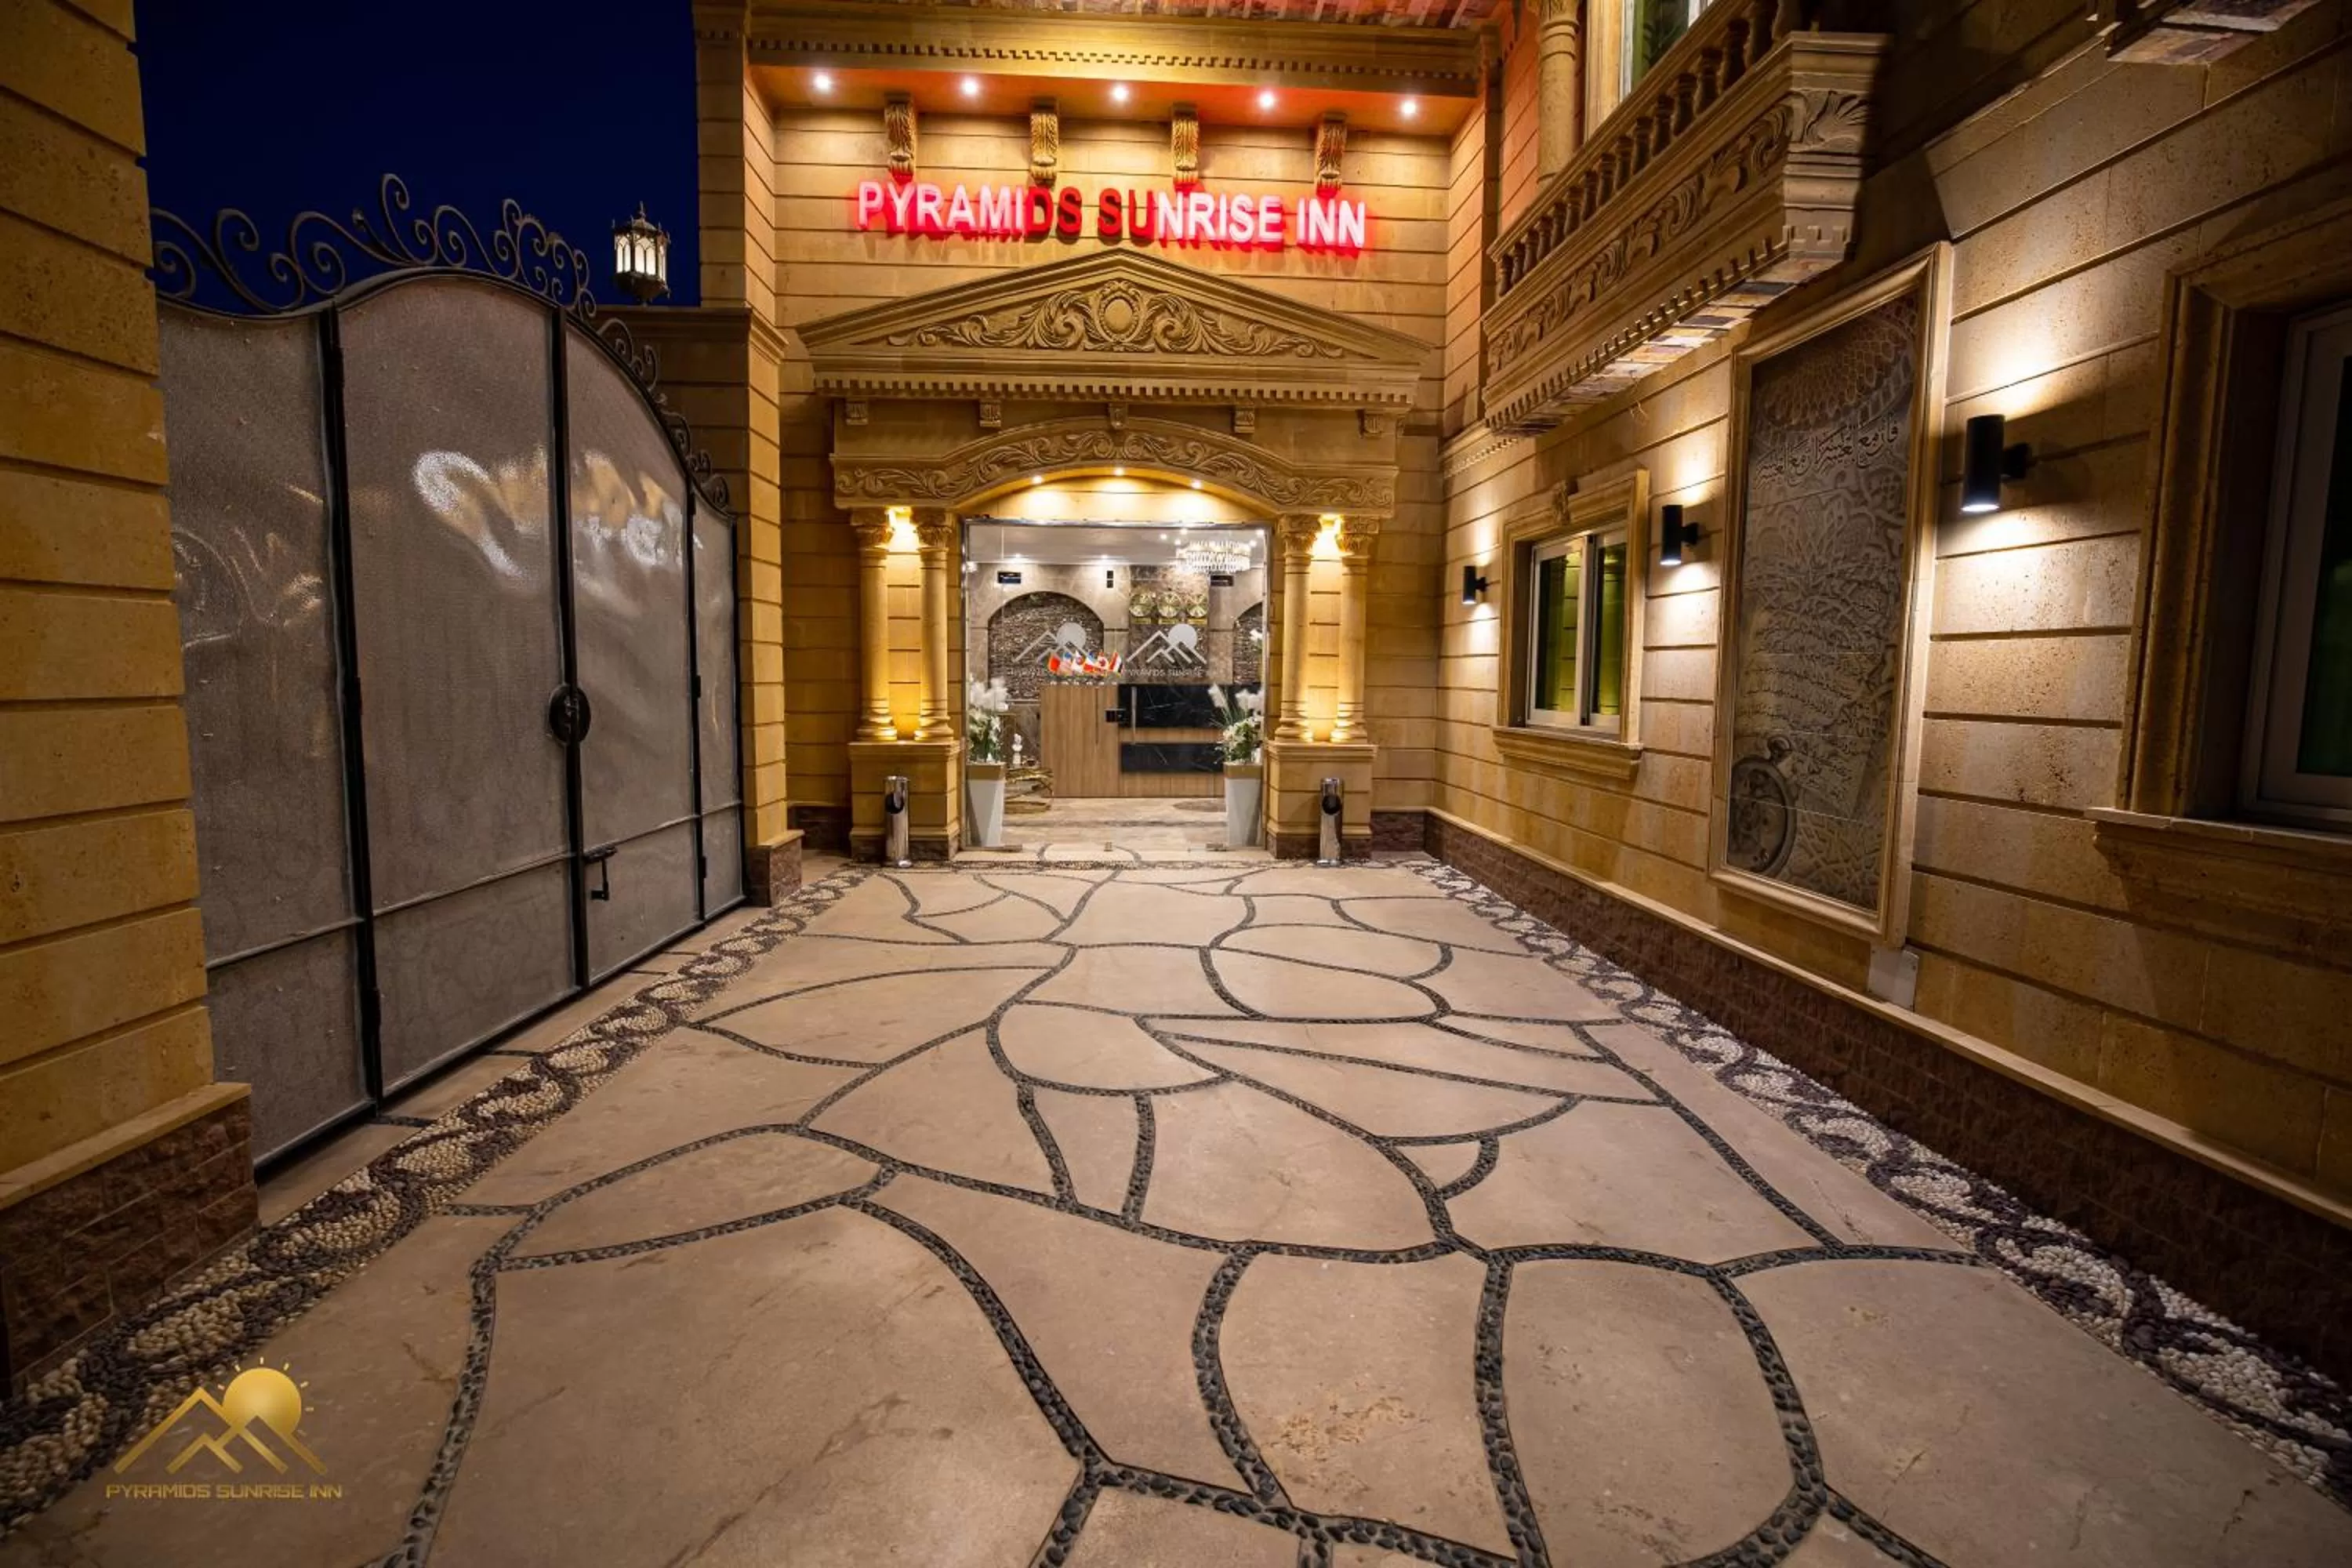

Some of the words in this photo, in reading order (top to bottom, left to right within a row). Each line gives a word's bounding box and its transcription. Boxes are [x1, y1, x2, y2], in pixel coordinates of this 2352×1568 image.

[858, 180, 1082, 234] PYRAMIDS
[1098, 187, 1283, 243] SUNRISE
[1297, 198, 1365, 249] INN
